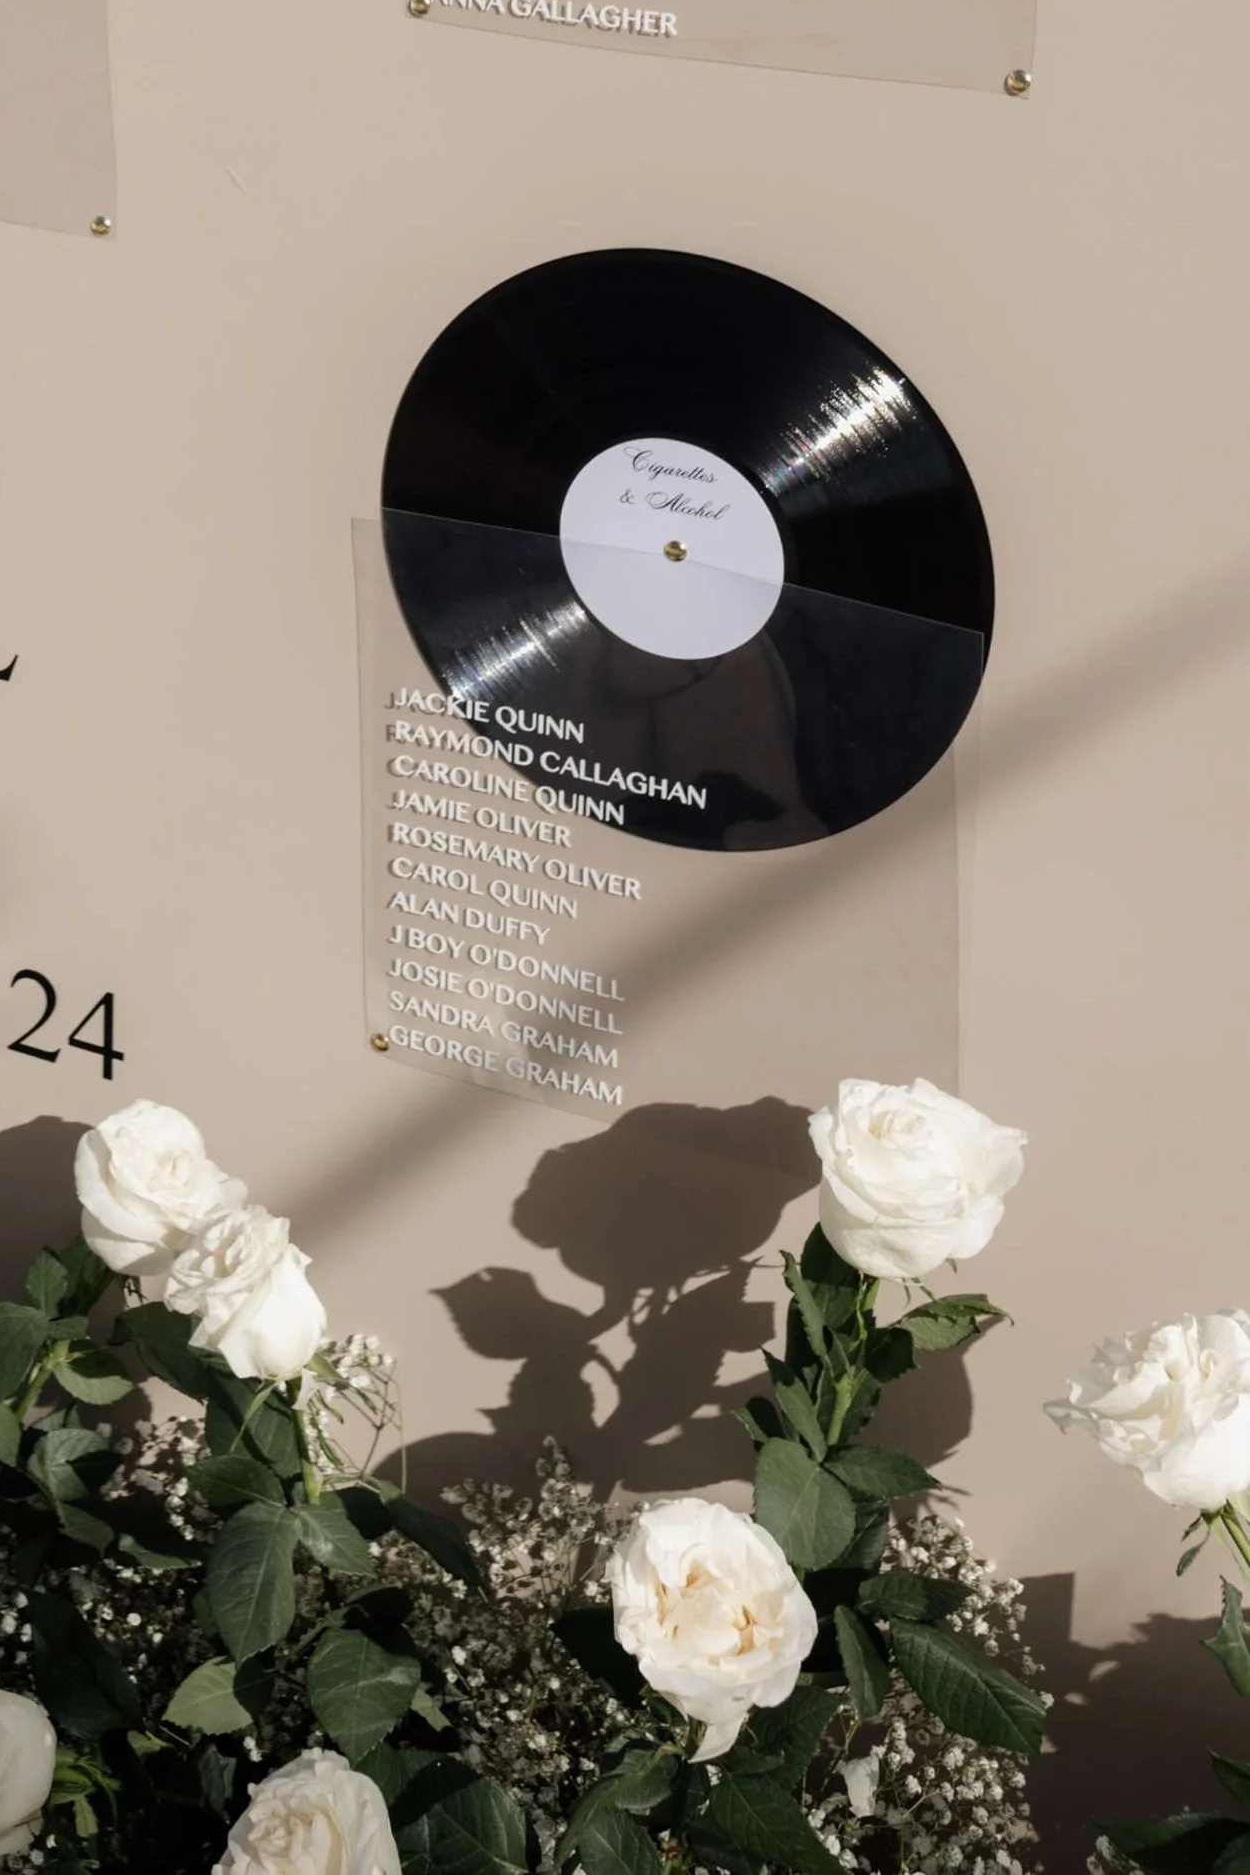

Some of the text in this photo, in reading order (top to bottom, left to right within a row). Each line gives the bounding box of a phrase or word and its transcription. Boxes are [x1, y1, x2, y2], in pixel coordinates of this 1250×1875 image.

[623, 446, 718, 484] Cigarettes
[620, 488, 732, 520] & Alcohol
[395, 688, 584, 744] JACKIE QUINN
[394, 755, 625, 825] CAROLINE QUINN
[395, 720, 707, 809] RAYMOND CALLAGHAN
[392, 789, 571, 847] JAMIE OLIVER
[392, 857, 578, 918] CAROL QUINN
[393, 823, 642, 900] ROSEMARY OLIVER
[391, 892, 551, 944] ALAN DUFFY
[390, 925, 625, 1001] J BOY O'DONNELL
[390, 958, 624, 1036] JOSIE O'DONNELL
[389, 991, 619, 1068] SANDRA GRAHAM
[389, 1025, 623, 1105] GEORGE GRAHAM
